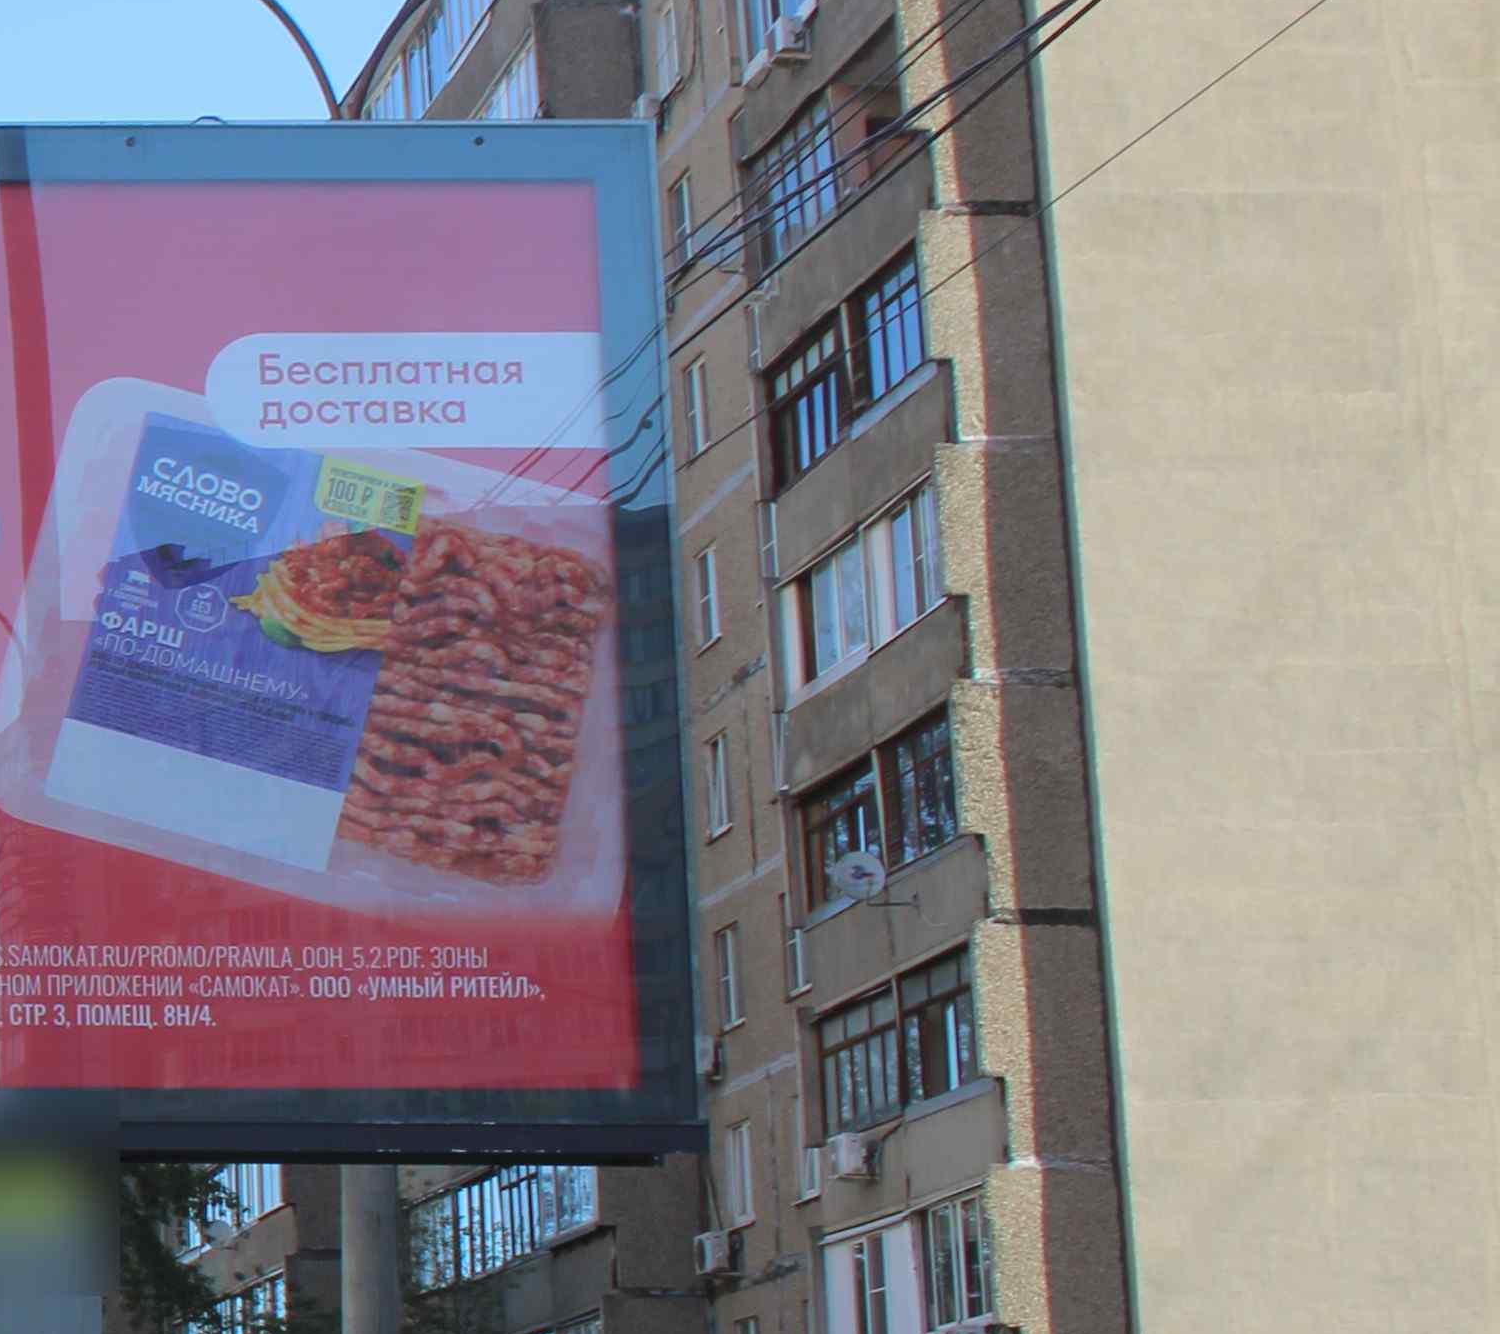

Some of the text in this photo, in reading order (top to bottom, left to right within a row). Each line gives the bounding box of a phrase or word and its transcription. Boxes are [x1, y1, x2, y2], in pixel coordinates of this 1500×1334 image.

[258, 353, 524, 385] Бесплатная
[258, 399, 467, 430] доставка
[152, 456, 264, 512] СЛОВО
[136, 474, 261, 534] МЯСНИКА
[101, 611, 185, 648] ФАРШ
[430, 946, 488, 969] ЗОНЫ
[47, 974, 183, 997] ПРИЛОЖЕНИИ
[309, 975, 351, 999] ООО
[357, 971, 445, 1000] «УМНЫЙ
[450, 971, 546, 1000] РИТЕЙЛ»,
[9, 1003, 49, 1027] СТР.
[53, 1003, 71, 1028] 3,
[75, 1004, 159, 1030] ПОМЕЩ.
[163, 1004, 217, 1027] 8Н/4.
